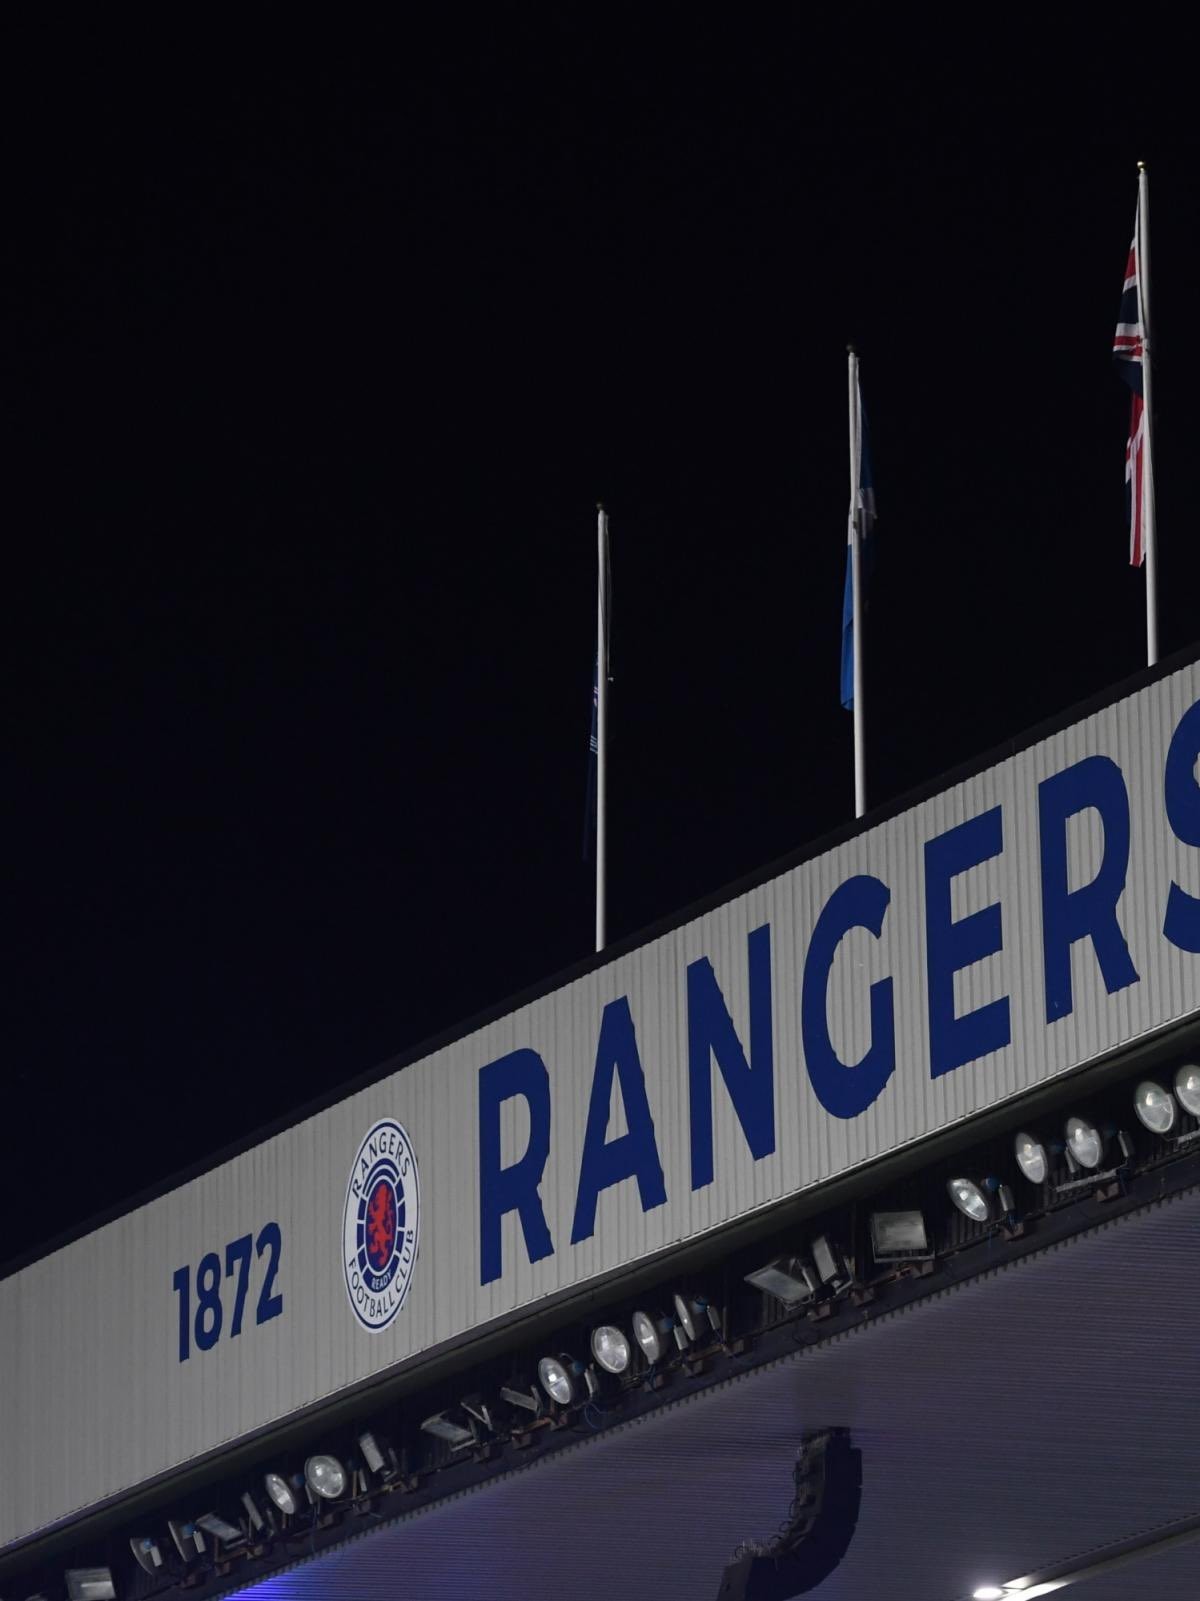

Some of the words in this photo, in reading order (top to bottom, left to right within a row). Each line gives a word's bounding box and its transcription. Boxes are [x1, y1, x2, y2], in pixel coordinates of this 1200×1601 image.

[352, 1132, 411, 1199] RANGERS
[172, 1222, 284, 1363] 1872
[349, 1256, 395, 1318] FOOTBALL
[394, 1230, 414, 1294] CLUB
[371, 1269, 392, 1291] READY
